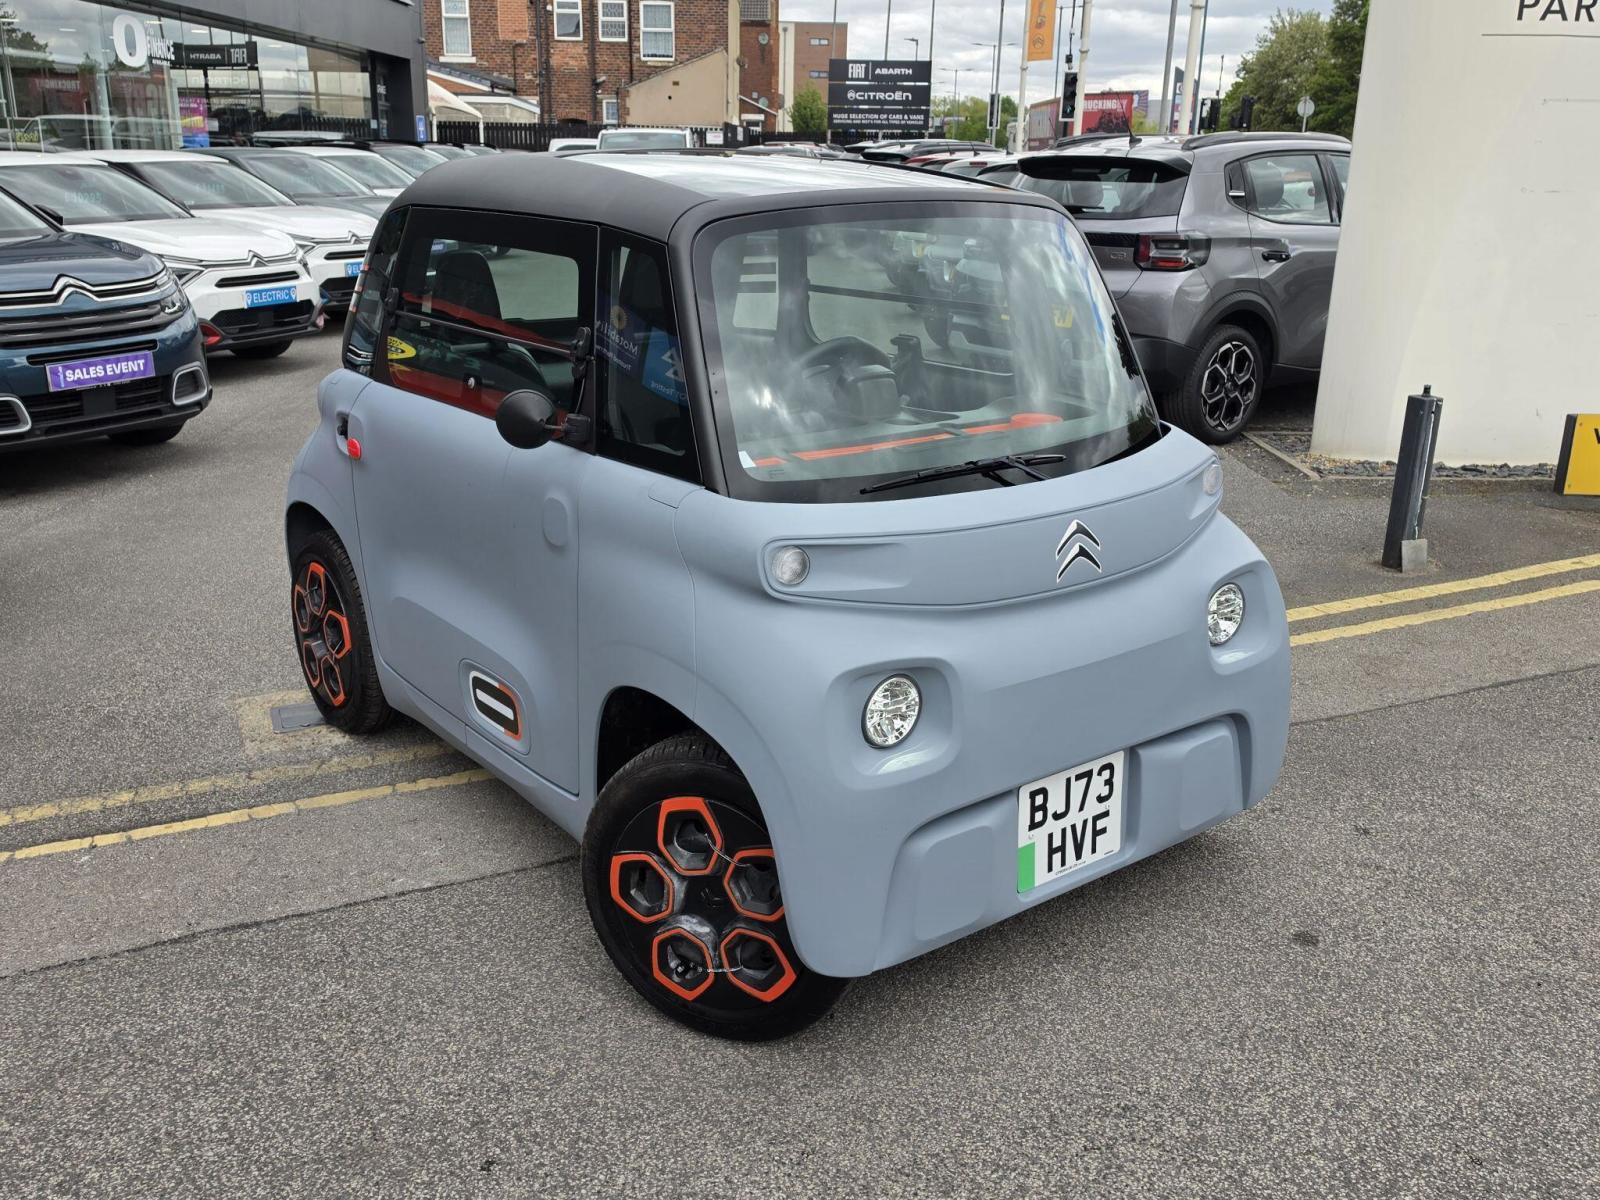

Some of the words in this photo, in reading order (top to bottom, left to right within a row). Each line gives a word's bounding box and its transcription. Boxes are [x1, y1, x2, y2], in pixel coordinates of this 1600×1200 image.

[147, 36, 175, 61] FINANCE
[848, 63, 866, 79] FIAT
[874, 67, 913, 75] ABARTH
[253, 289, 290, 303] ELECTRIC
[65, 364, 105, 382] SALES
[106, 359, 145, 376] EVENT
[1028, 762, 1115, 832] BJ73
[1047, 809, 1110, 874] HVF
